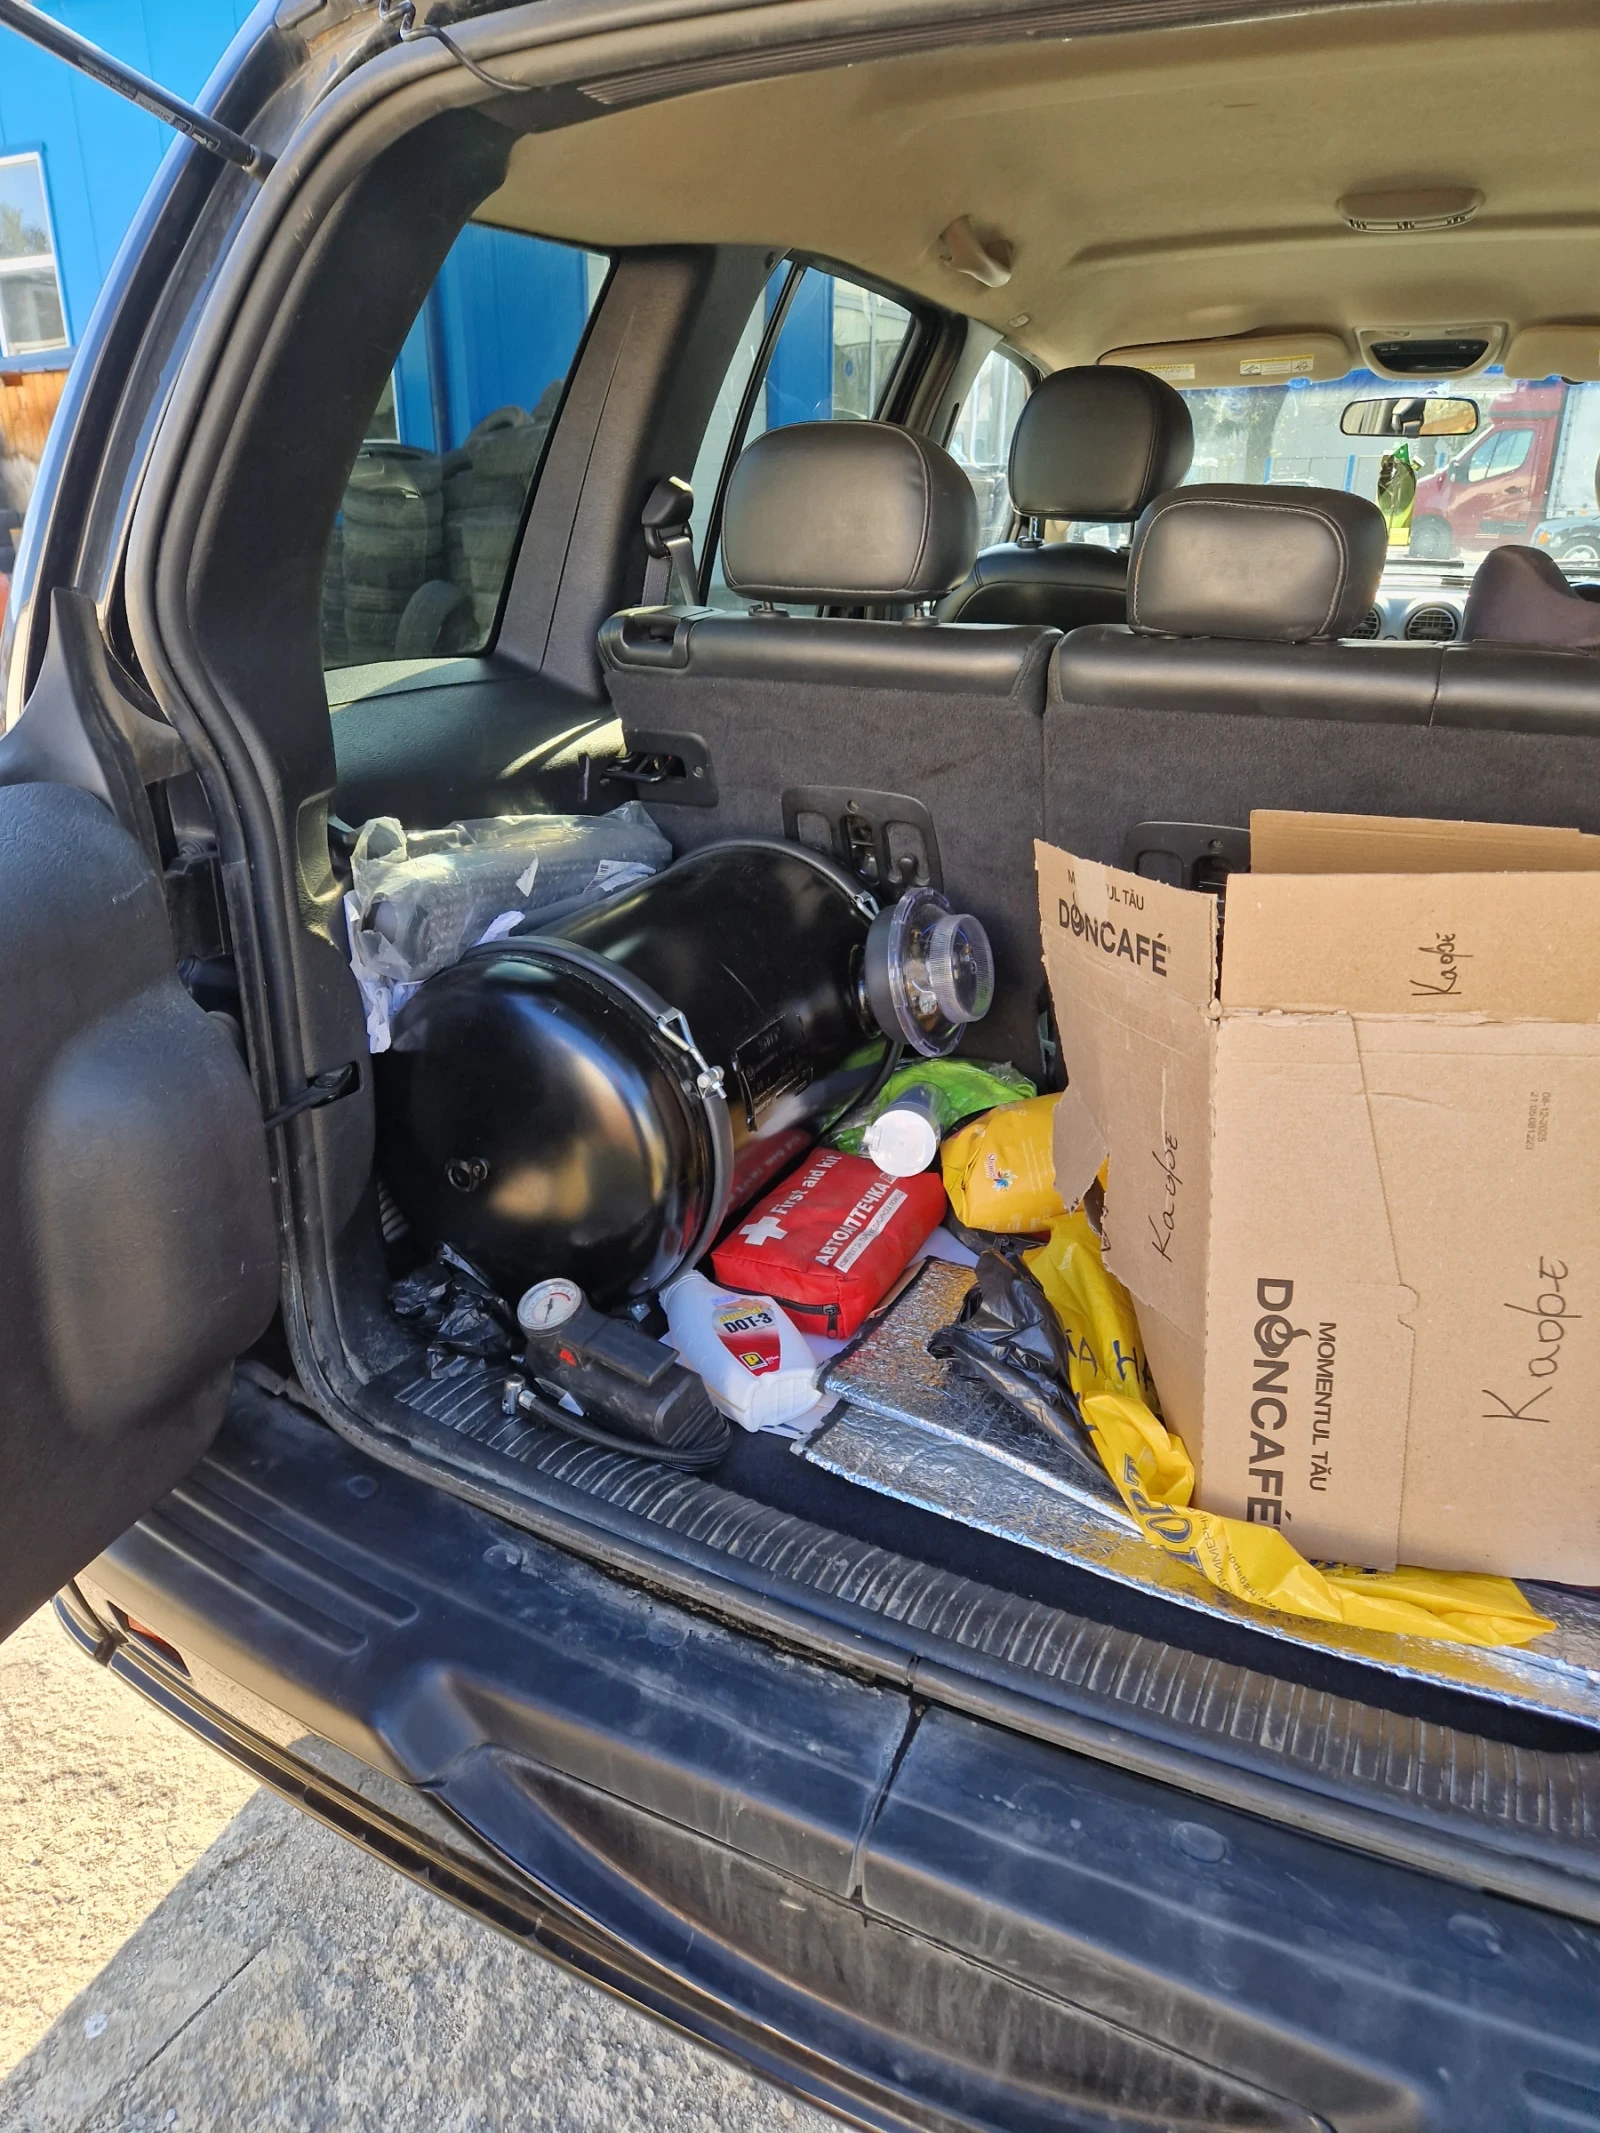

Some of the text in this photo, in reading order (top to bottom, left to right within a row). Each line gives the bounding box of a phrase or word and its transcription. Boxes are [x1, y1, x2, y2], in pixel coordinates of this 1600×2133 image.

[1058, 895, 1167, 977] DONCAFÉ
[1122, 888, 1144, 911] TĂU
[769, 1154, 843, 1215] First aid kit
[814, 1182, 890, 1266] АВТОАПТЕЧКА
[723, 1312, 773, 1333] DOT-3
[1246, 1277, 1301, 1522] DONCAFÉ
[1309, 1322, 1337, 1492] MOMENTUL TĂU
